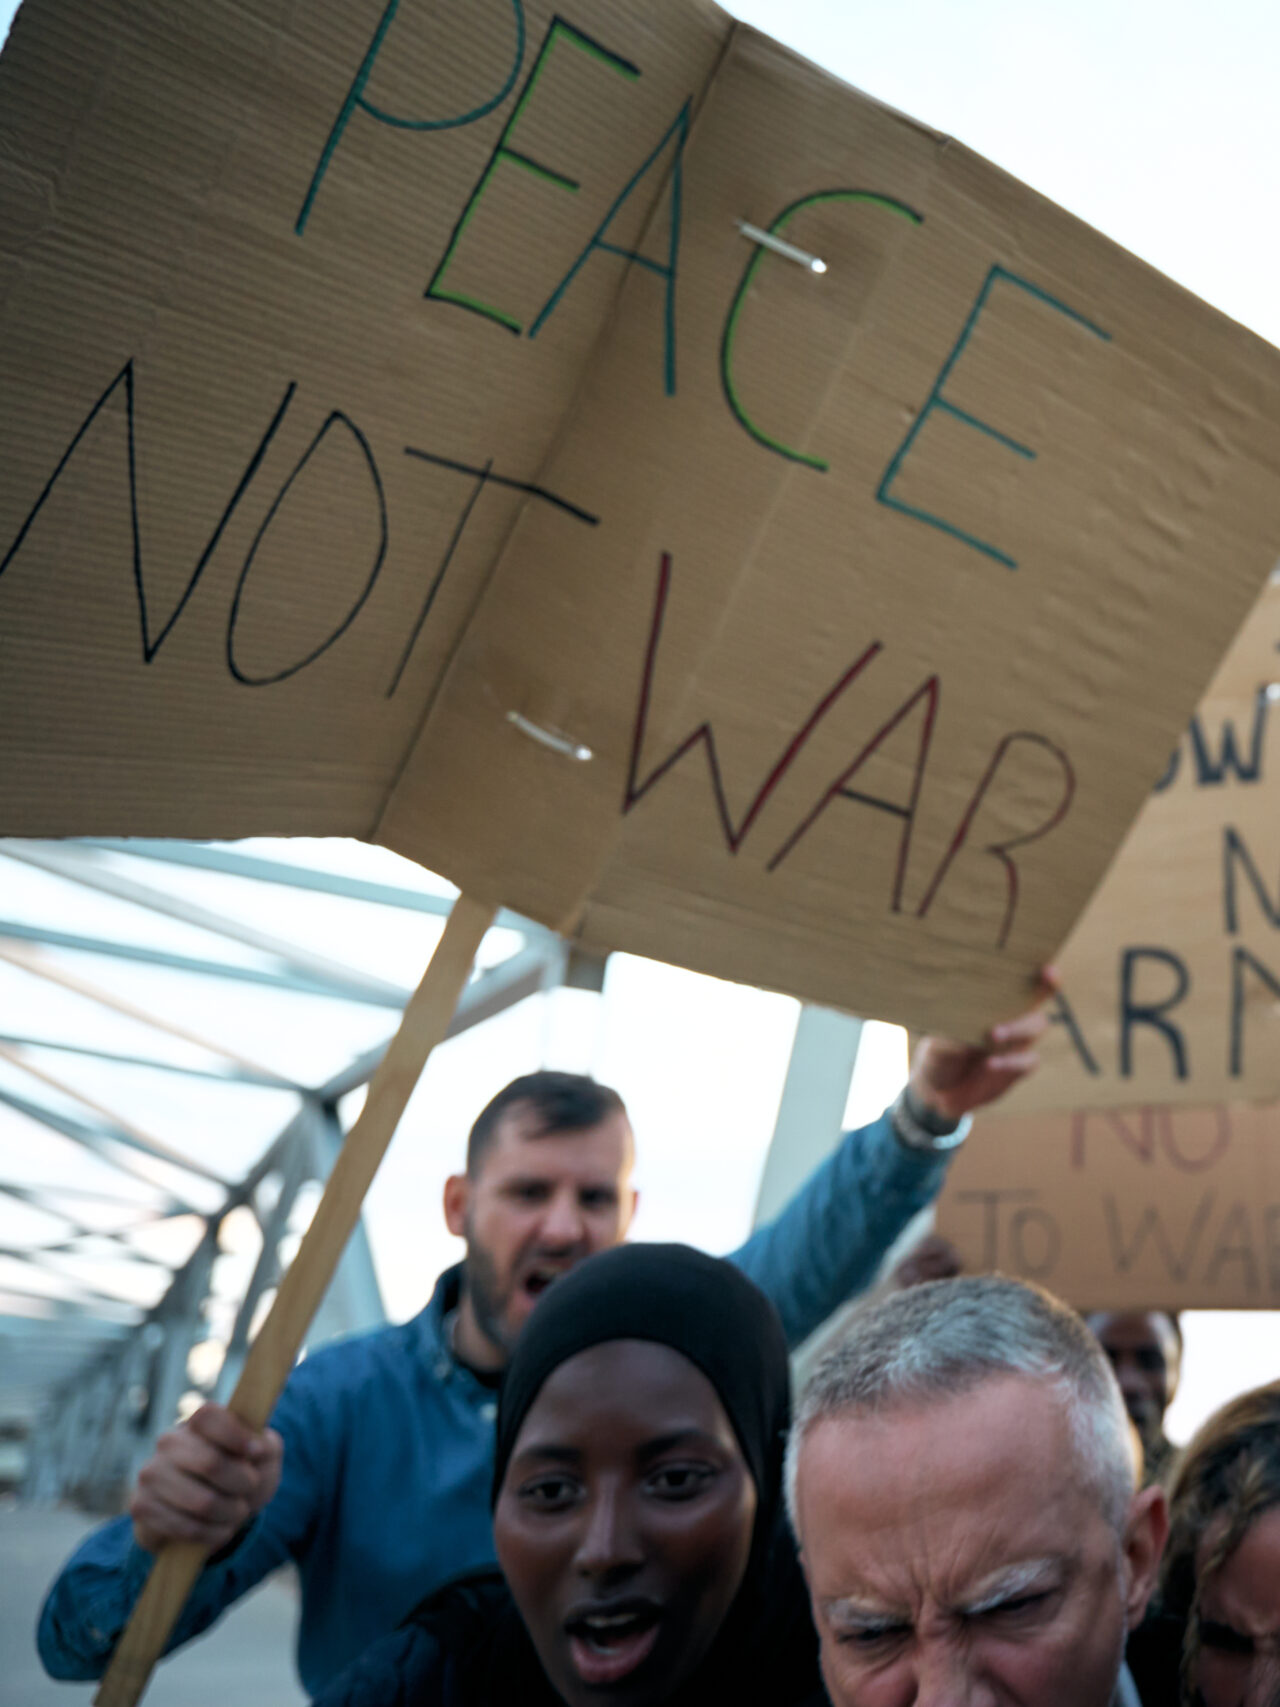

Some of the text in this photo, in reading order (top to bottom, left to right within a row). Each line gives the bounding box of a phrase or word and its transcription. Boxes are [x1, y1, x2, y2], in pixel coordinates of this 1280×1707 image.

[293, 0, 1112, 569] PEACE
[0, 357, 1076, 950] NOT WAR
[1069, 1105, 1233, 1174] NO
